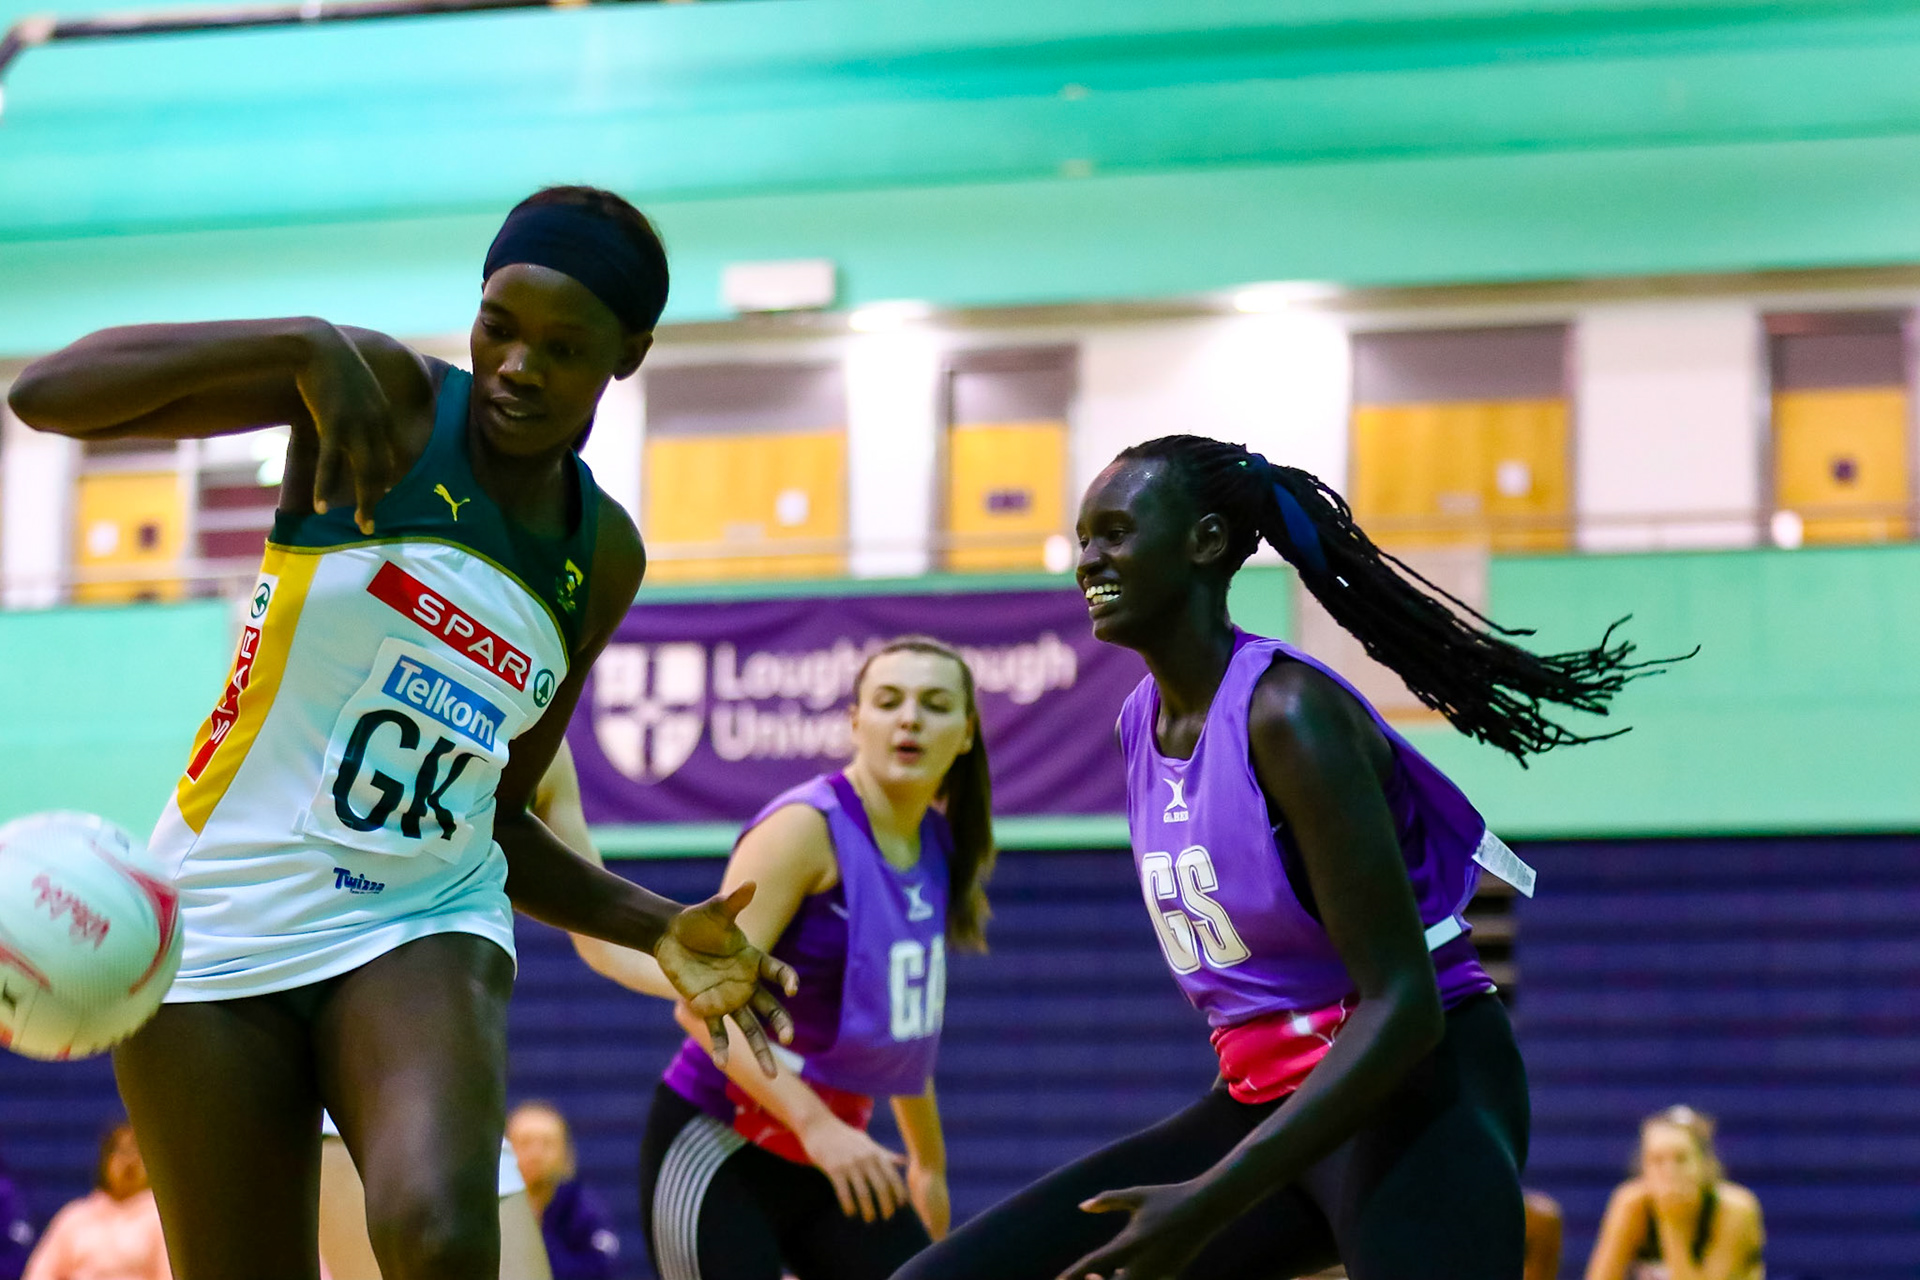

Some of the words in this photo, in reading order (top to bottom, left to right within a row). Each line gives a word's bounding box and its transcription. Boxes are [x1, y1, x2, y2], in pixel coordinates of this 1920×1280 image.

[413, 592, 529, 685] SPAR
[711, 633, 1078, 707] Loughough
[396, 660, 496, 746] Telkom
[331, 709, 489, 839] GK
[333, 867, 385, 891] Twizza
[1142, 845, 1251, 975] GS
[890, 934, 947, 1041] GA
